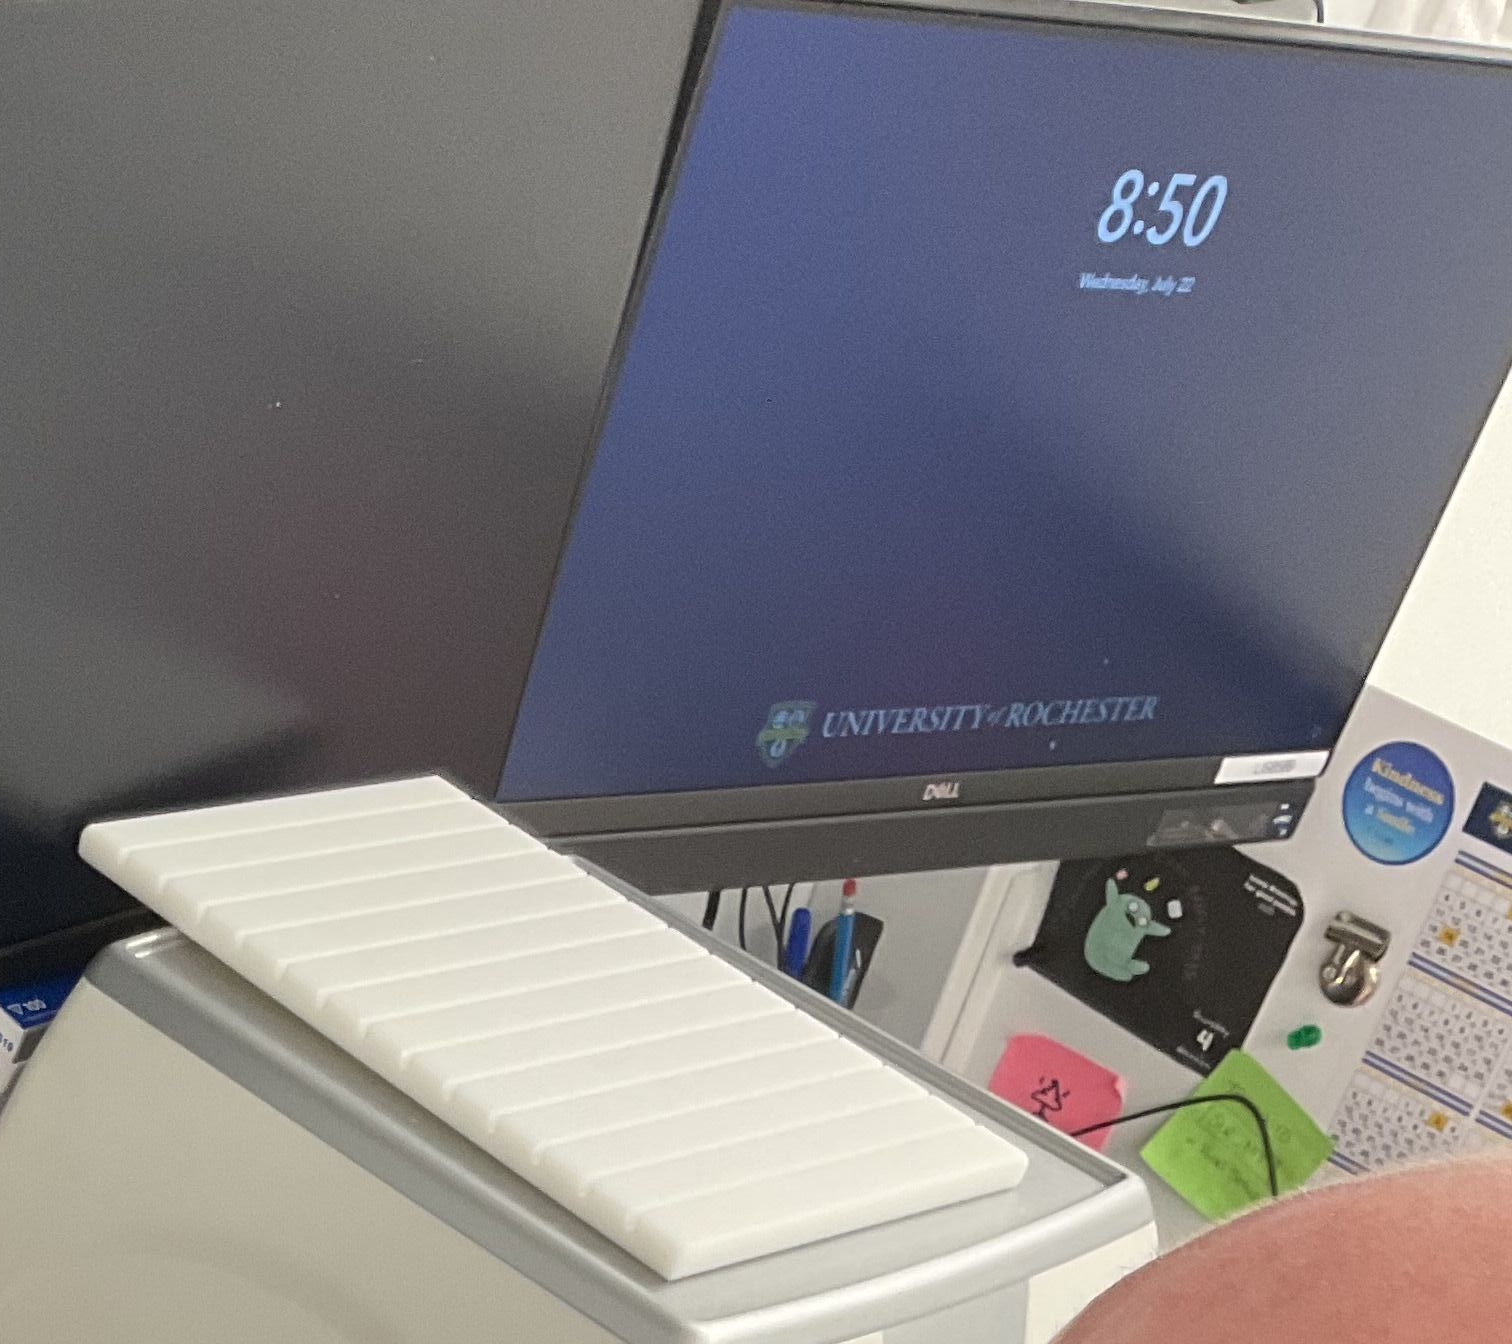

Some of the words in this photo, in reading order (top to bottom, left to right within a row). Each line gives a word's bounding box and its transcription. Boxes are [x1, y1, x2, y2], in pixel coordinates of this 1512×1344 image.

[1098, 169, 1228, 247] 8:50
[823, 705, 987, 737] UNIVERSITY
[1005, 696, 1159, 728] ROCHESTER
[922, 782, 960, 801] DELL
